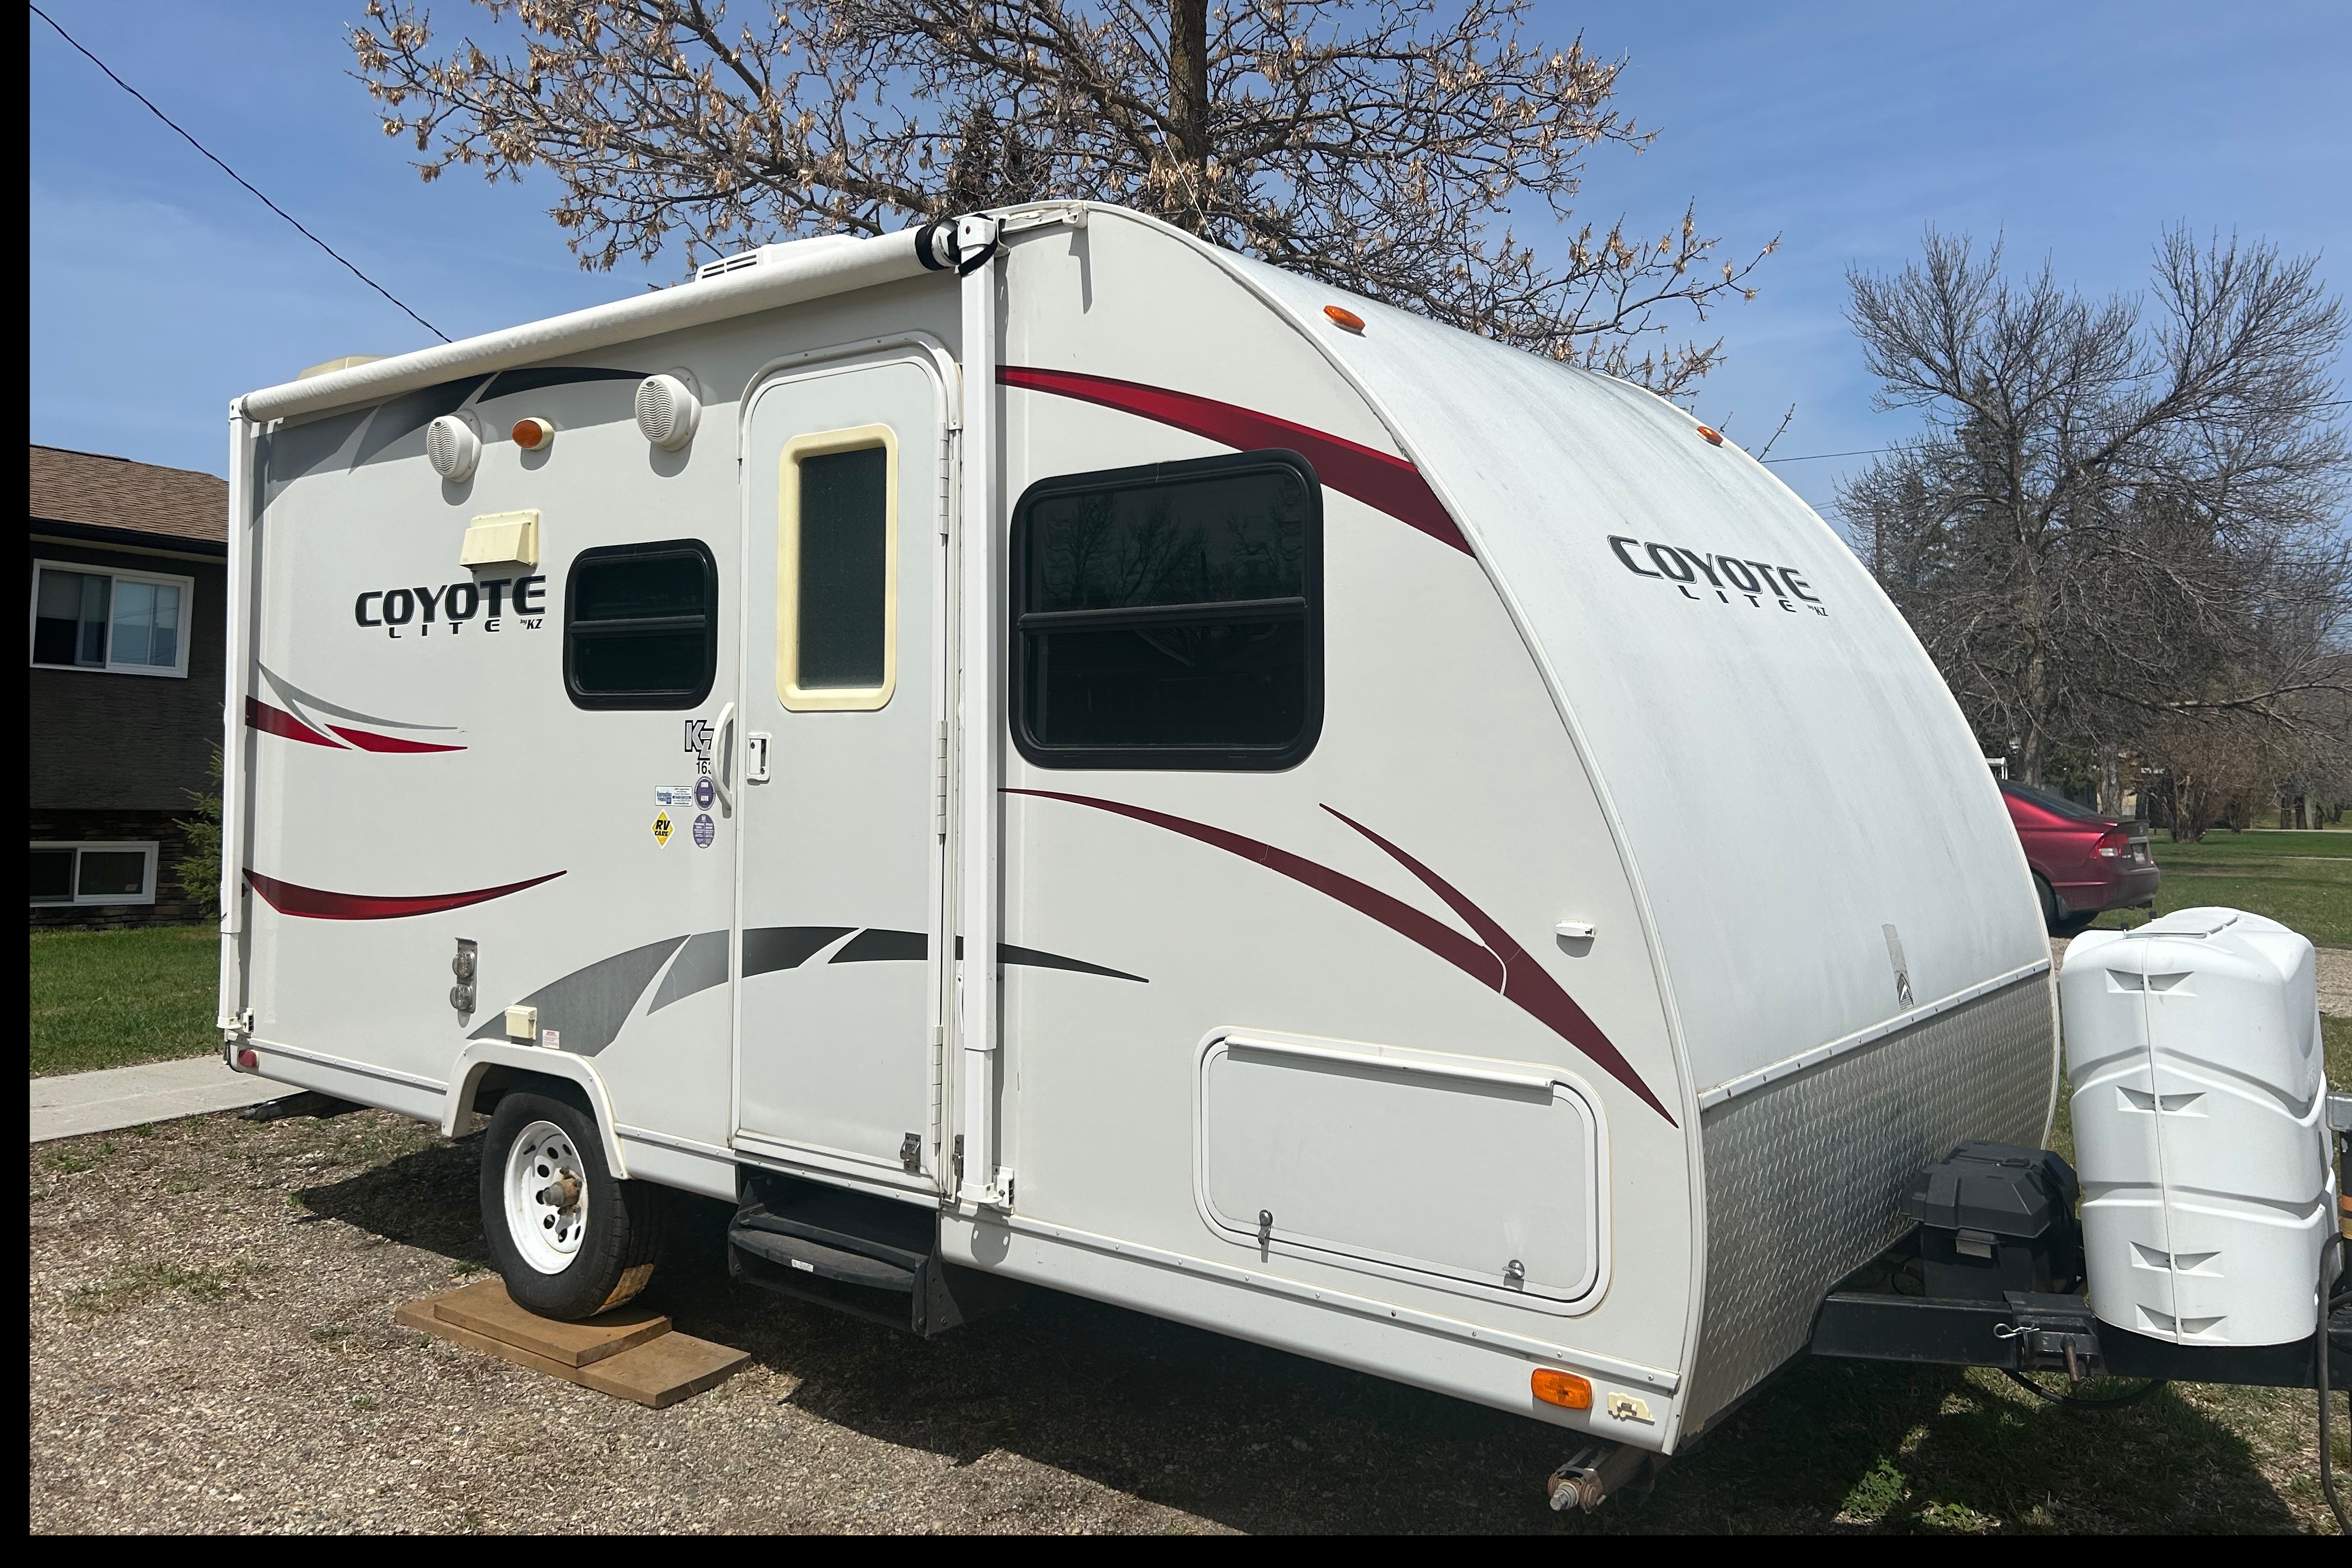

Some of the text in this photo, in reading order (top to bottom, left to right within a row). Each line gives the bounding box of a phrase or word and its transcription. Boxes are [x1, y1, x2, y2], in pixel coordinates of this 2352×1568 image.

[1607, 534, 1822, 603] COYOTE
[355, 575, 546, 627] COYOTE
[1678, 585, 1797, 612] LITE
[1814, 606, 1829, 617] KZ
[389, 620, 500, 639] LITE
[526, 618, 543, 629] KZ
[655, 820, 670, 831] RV
